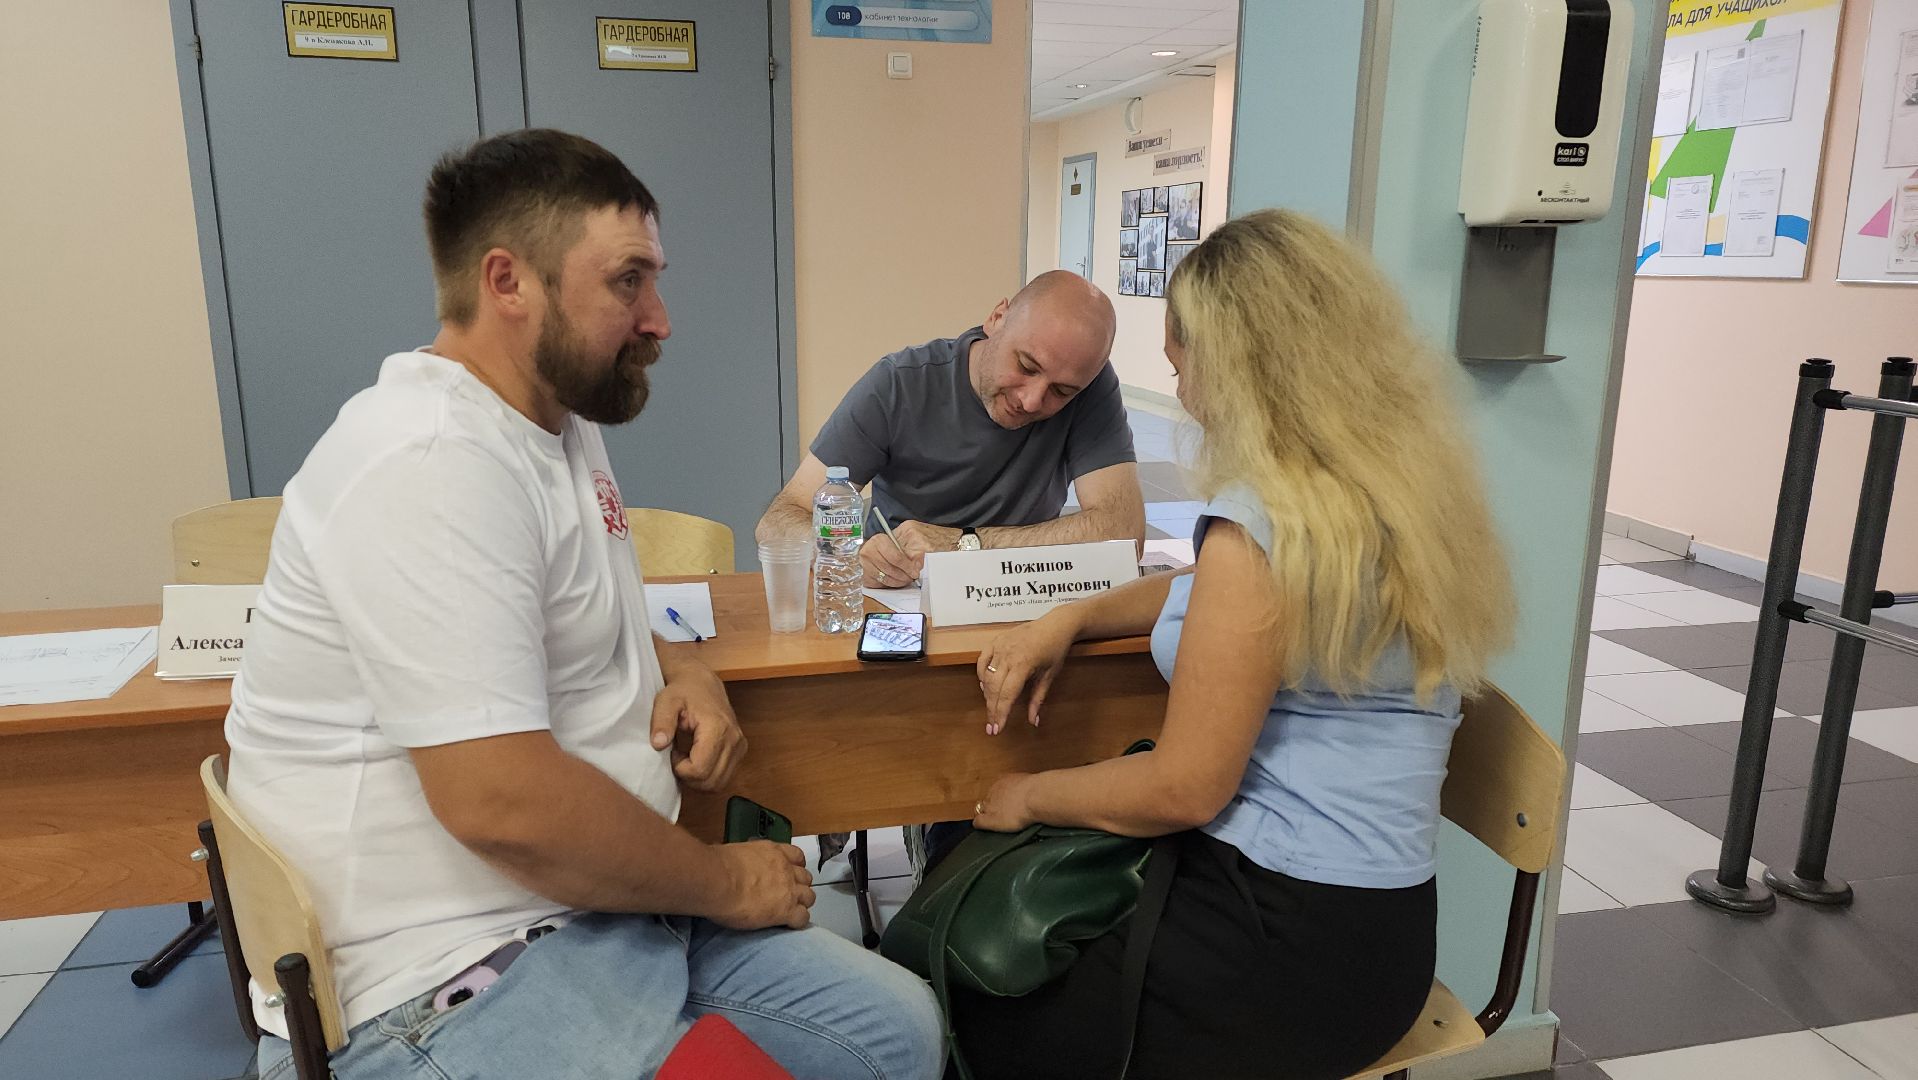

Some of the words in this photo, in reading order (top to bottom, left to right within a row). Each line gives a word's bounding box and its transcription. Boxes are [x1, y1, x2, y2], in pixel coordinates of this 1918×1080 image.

[291, 9, 387, 30] ГАРДЕРОБНАЯ
[837, 11, 851, 20] 108
[864, 13, 896, 21] кабинет
[898, 14, 938, 23] технологии
[1684, 6, 1712, 28] ДЛЯ
[603, 24, 689, 43] ГАРДЕРОБНАЯ
[821, 515, 860, 526] СЕНЕЖСКАЯ
[1000, 560, 1074, 575] Ножинов
[964, 585, 1022, 601] Руслан
[1026, 579, 1112, 598] Харисович
[169, 635, 244, 651] Алекса
